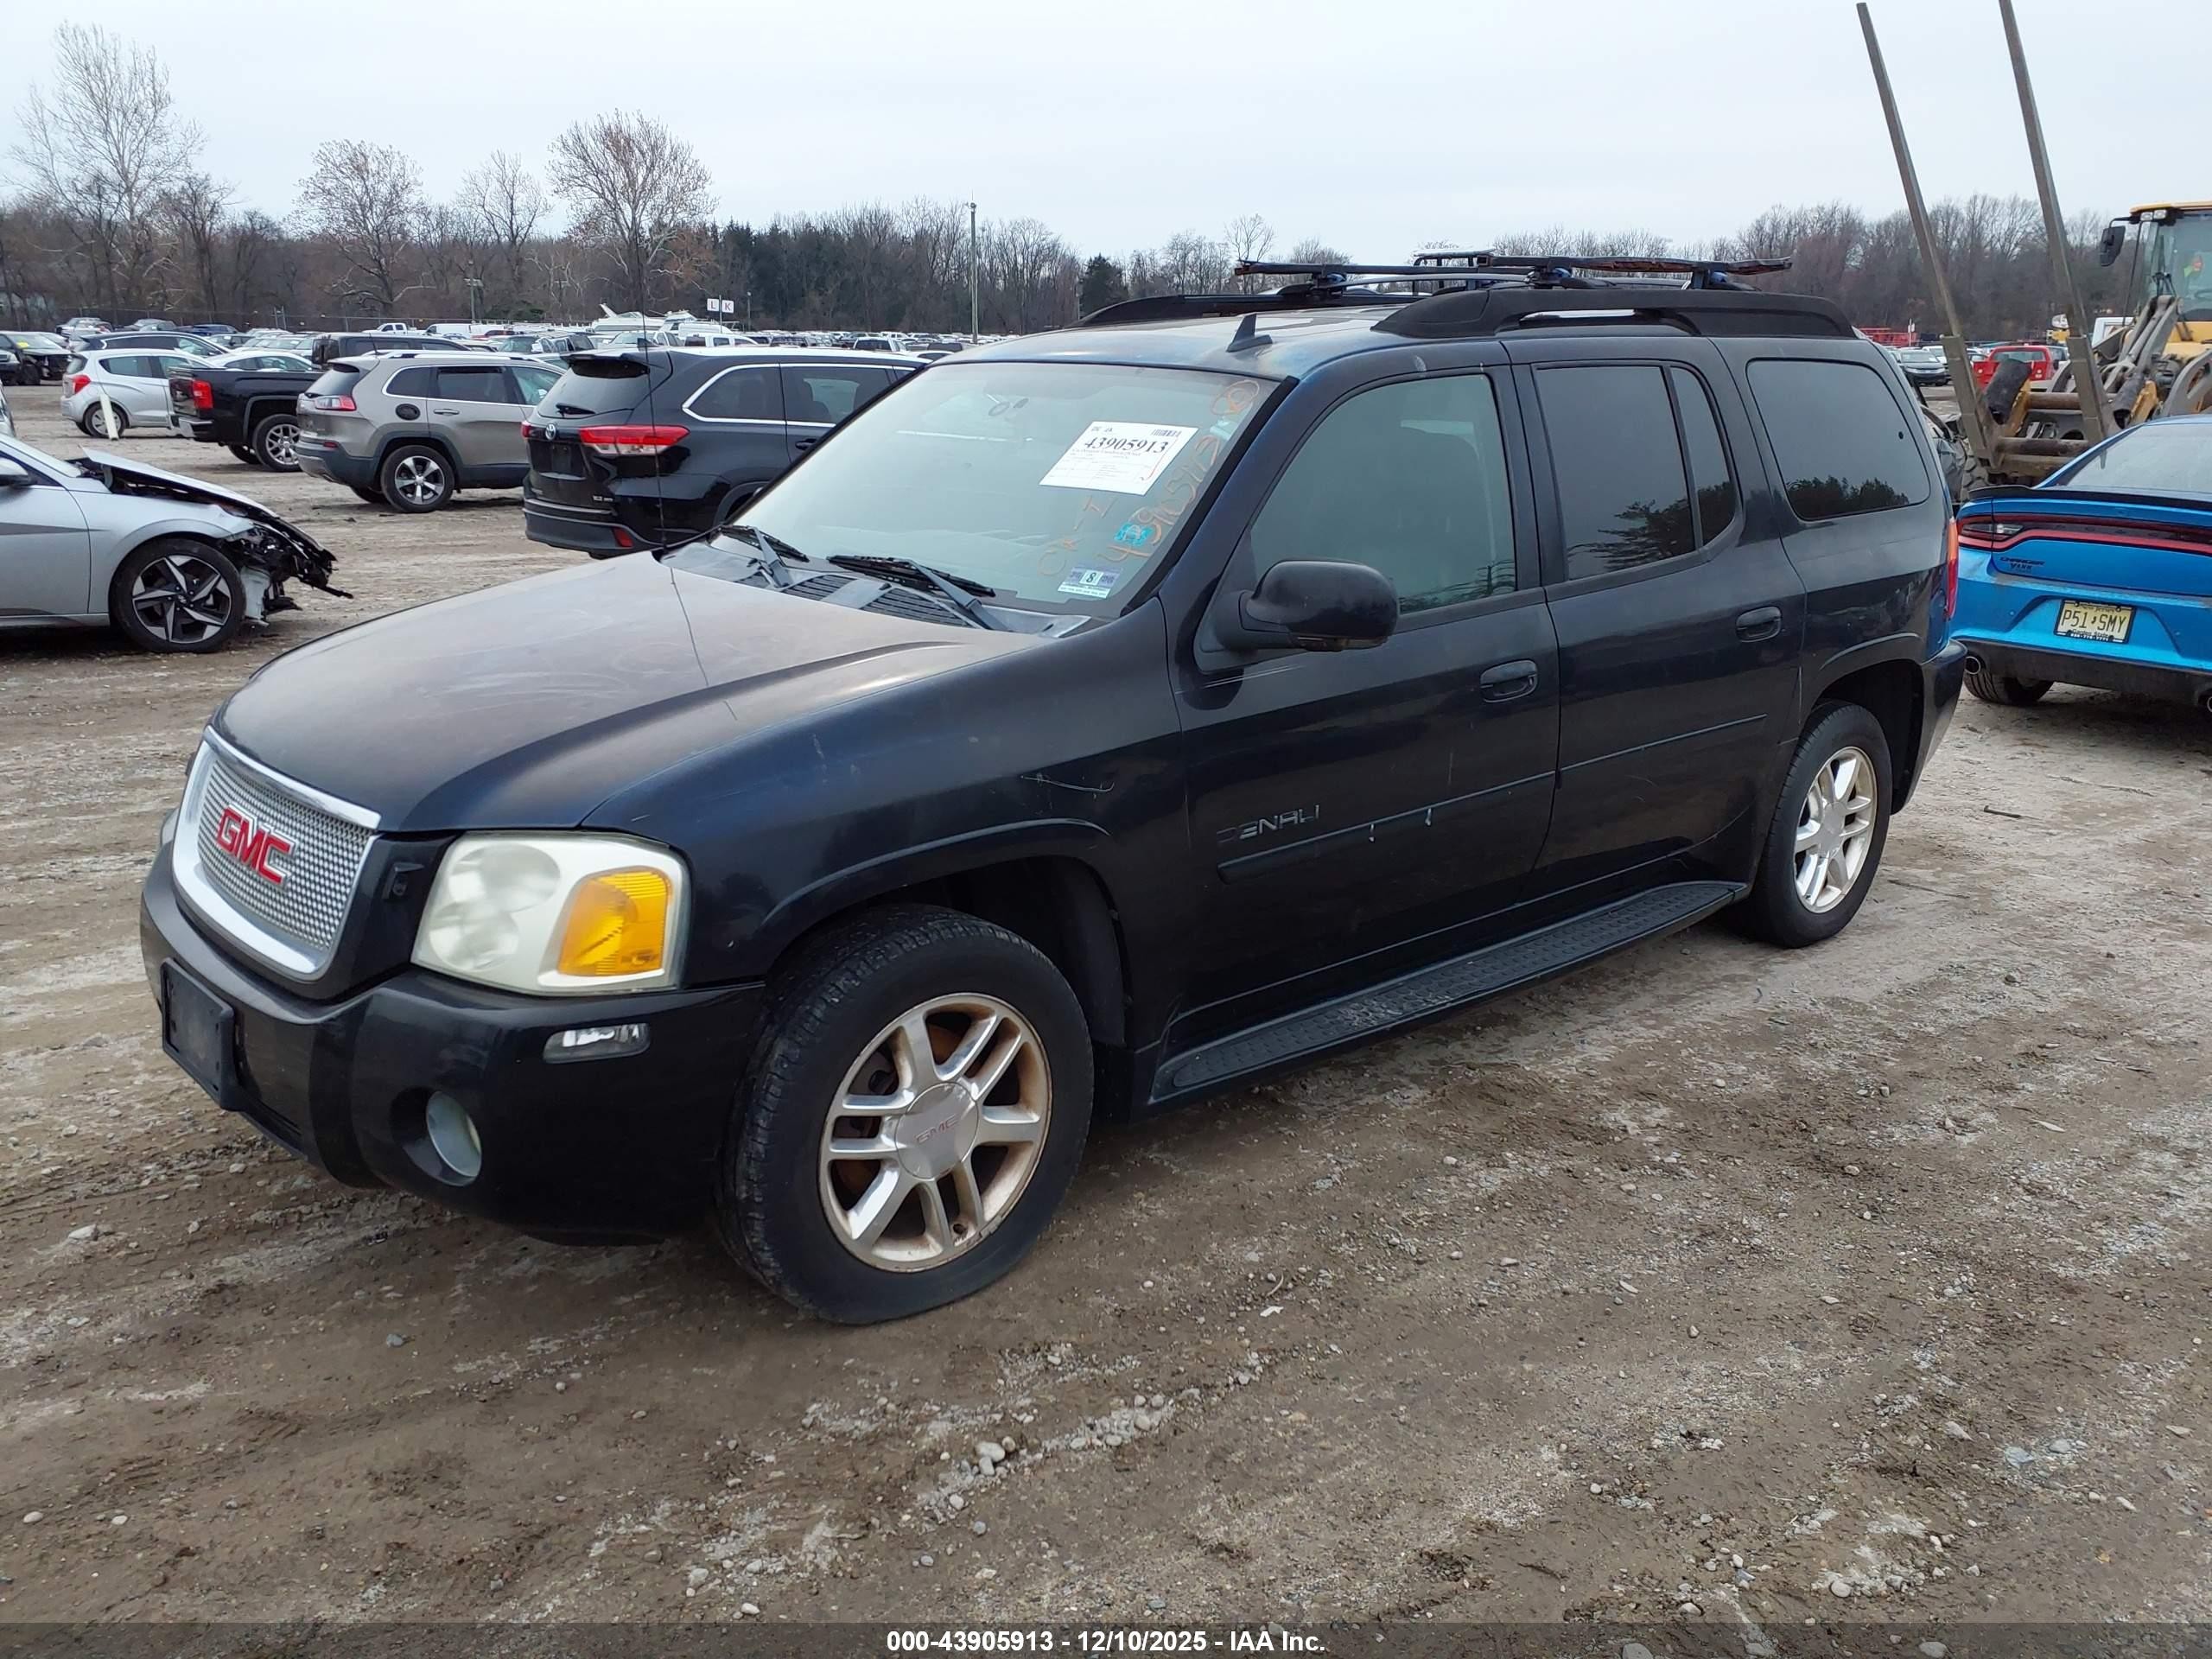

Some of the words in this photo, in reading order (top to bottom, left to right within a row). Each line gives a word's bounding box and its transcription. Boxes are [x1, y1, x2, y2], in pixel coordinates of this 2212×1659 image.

[710, 301, 716, 309] L
[725, 302, 731, 312] K
[1084, 437, 1169, 454] 43905913
[1086, 572, 1096, 583] 8
[216, 802, 299, 886] GMC
[915, 1114, 959, 1143] GMC
